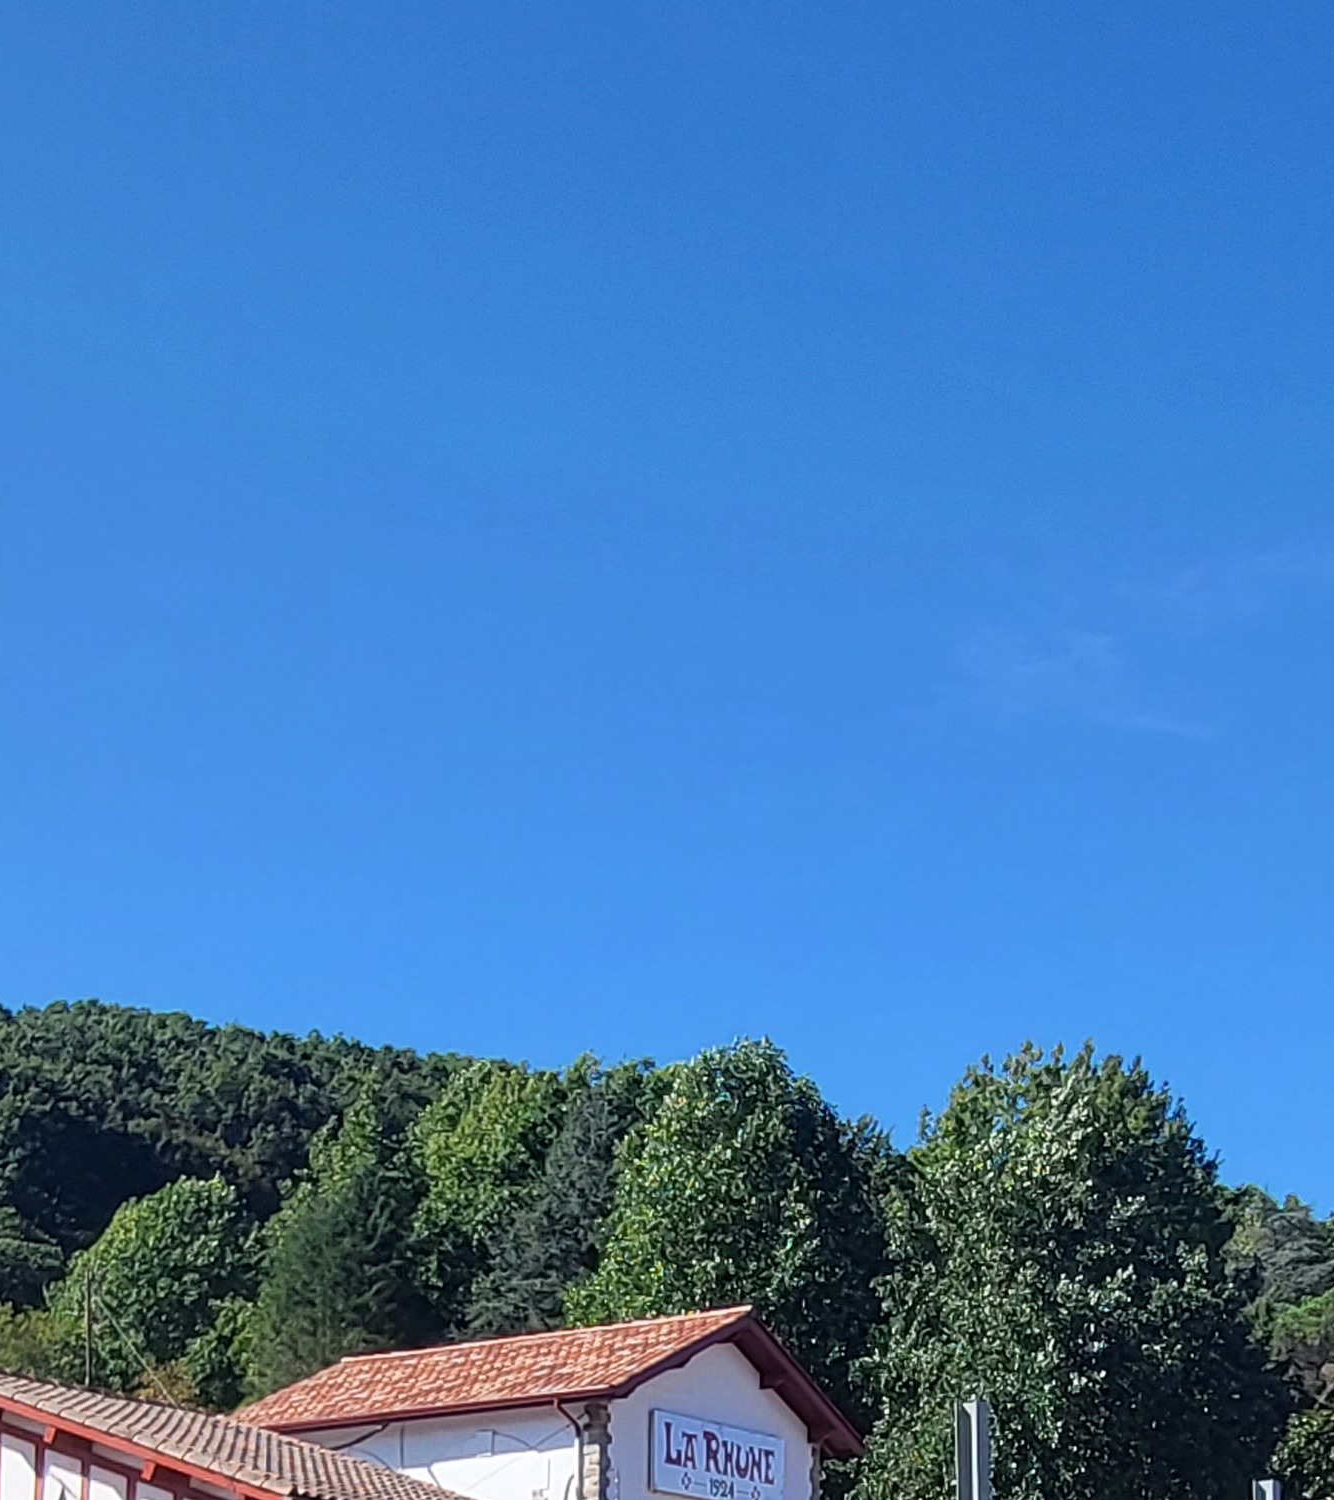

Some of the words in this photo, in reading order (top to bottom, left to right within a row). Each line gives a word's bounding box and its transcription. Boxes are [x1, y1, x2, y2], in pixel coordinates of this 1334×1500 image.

[664, 1421, 698, 1470] LA
[703, 1430, 776, 1485] RHUNE
[709, 1478, 734, 1499] 1924
